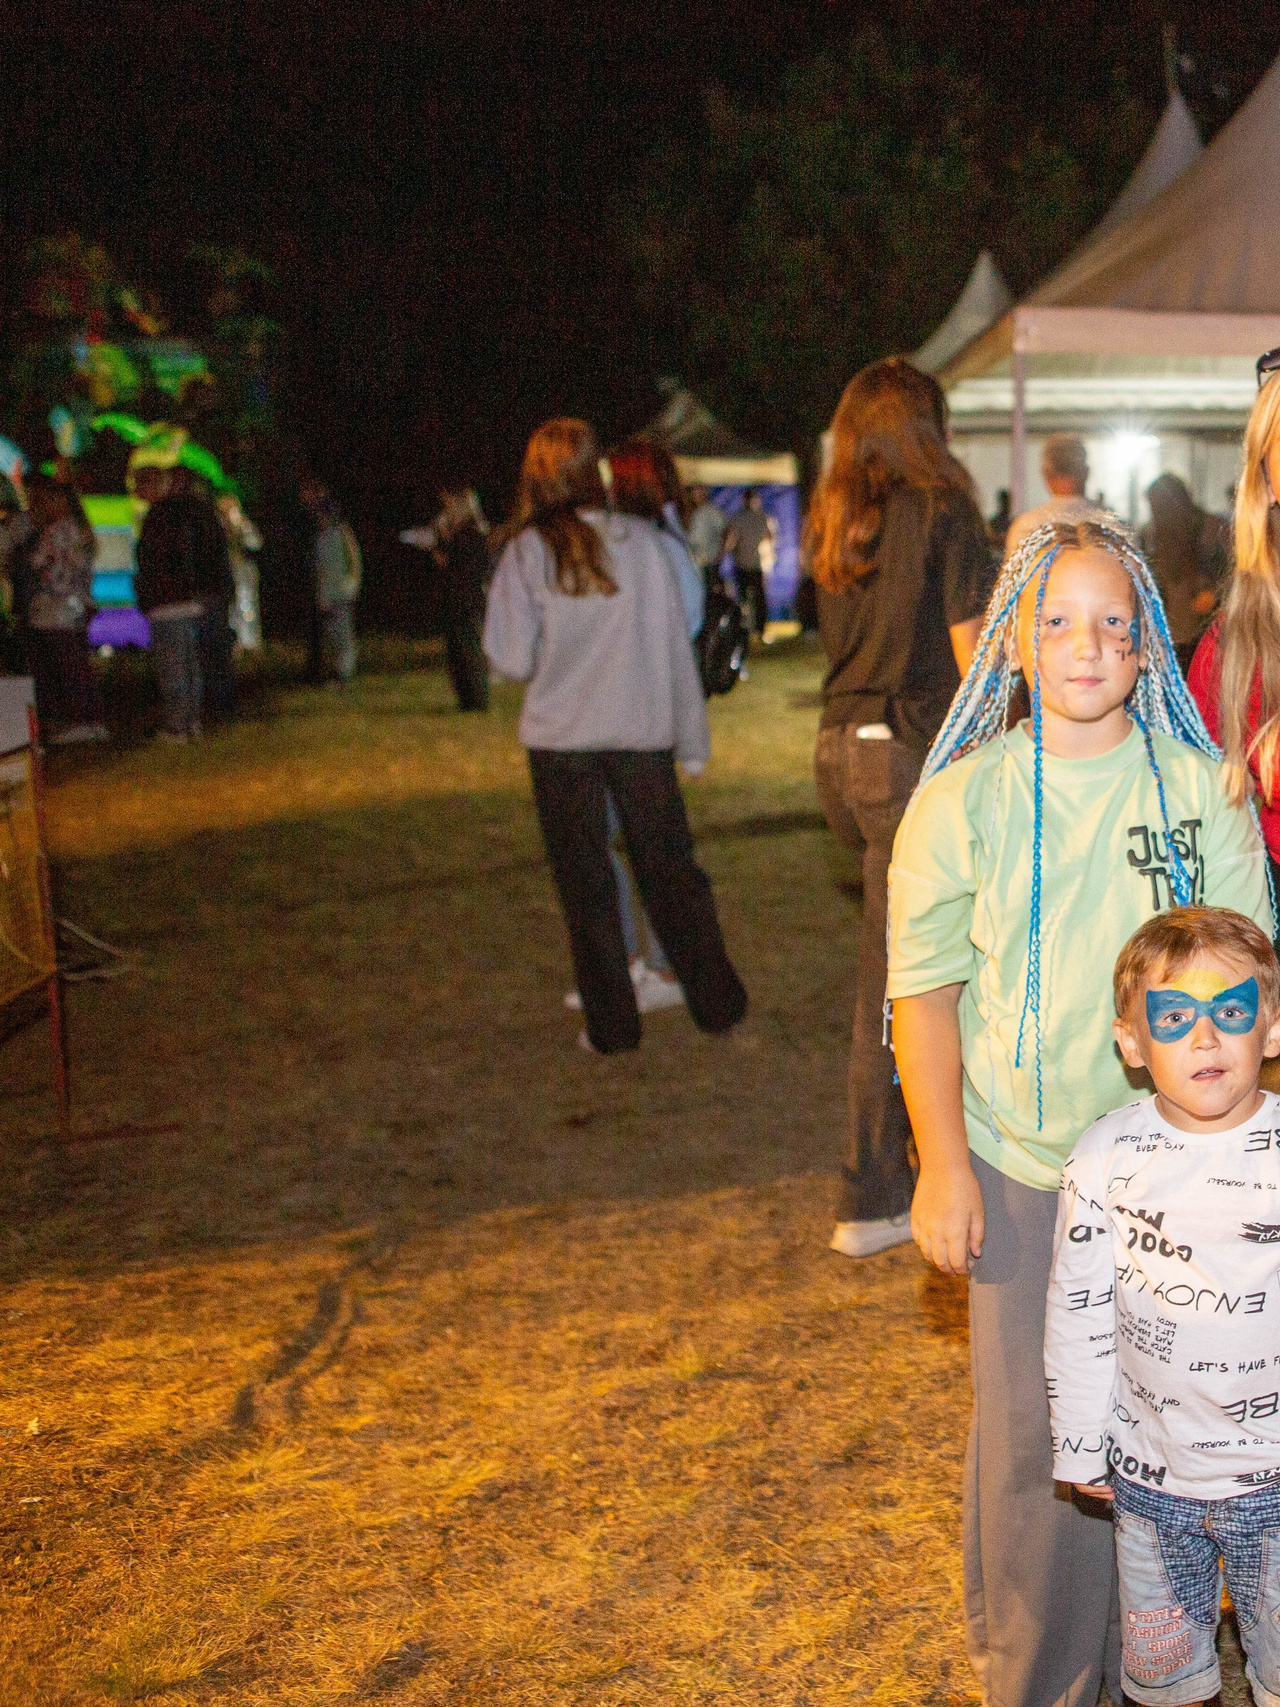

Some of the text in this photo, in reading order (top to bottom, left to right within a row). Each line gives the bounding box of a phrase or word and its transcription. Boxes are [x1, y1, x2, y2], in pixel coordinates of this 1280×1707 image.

[1127, 819, 1203, 867] JUST
[1153, 1281, 1266, 1315] ENJOY
[1189, 1362, 1228, 1373] LET'S
[1238, 1359, 1267, 1374] HAVE
[1148, 1630, 1191, 1653] SPORT
